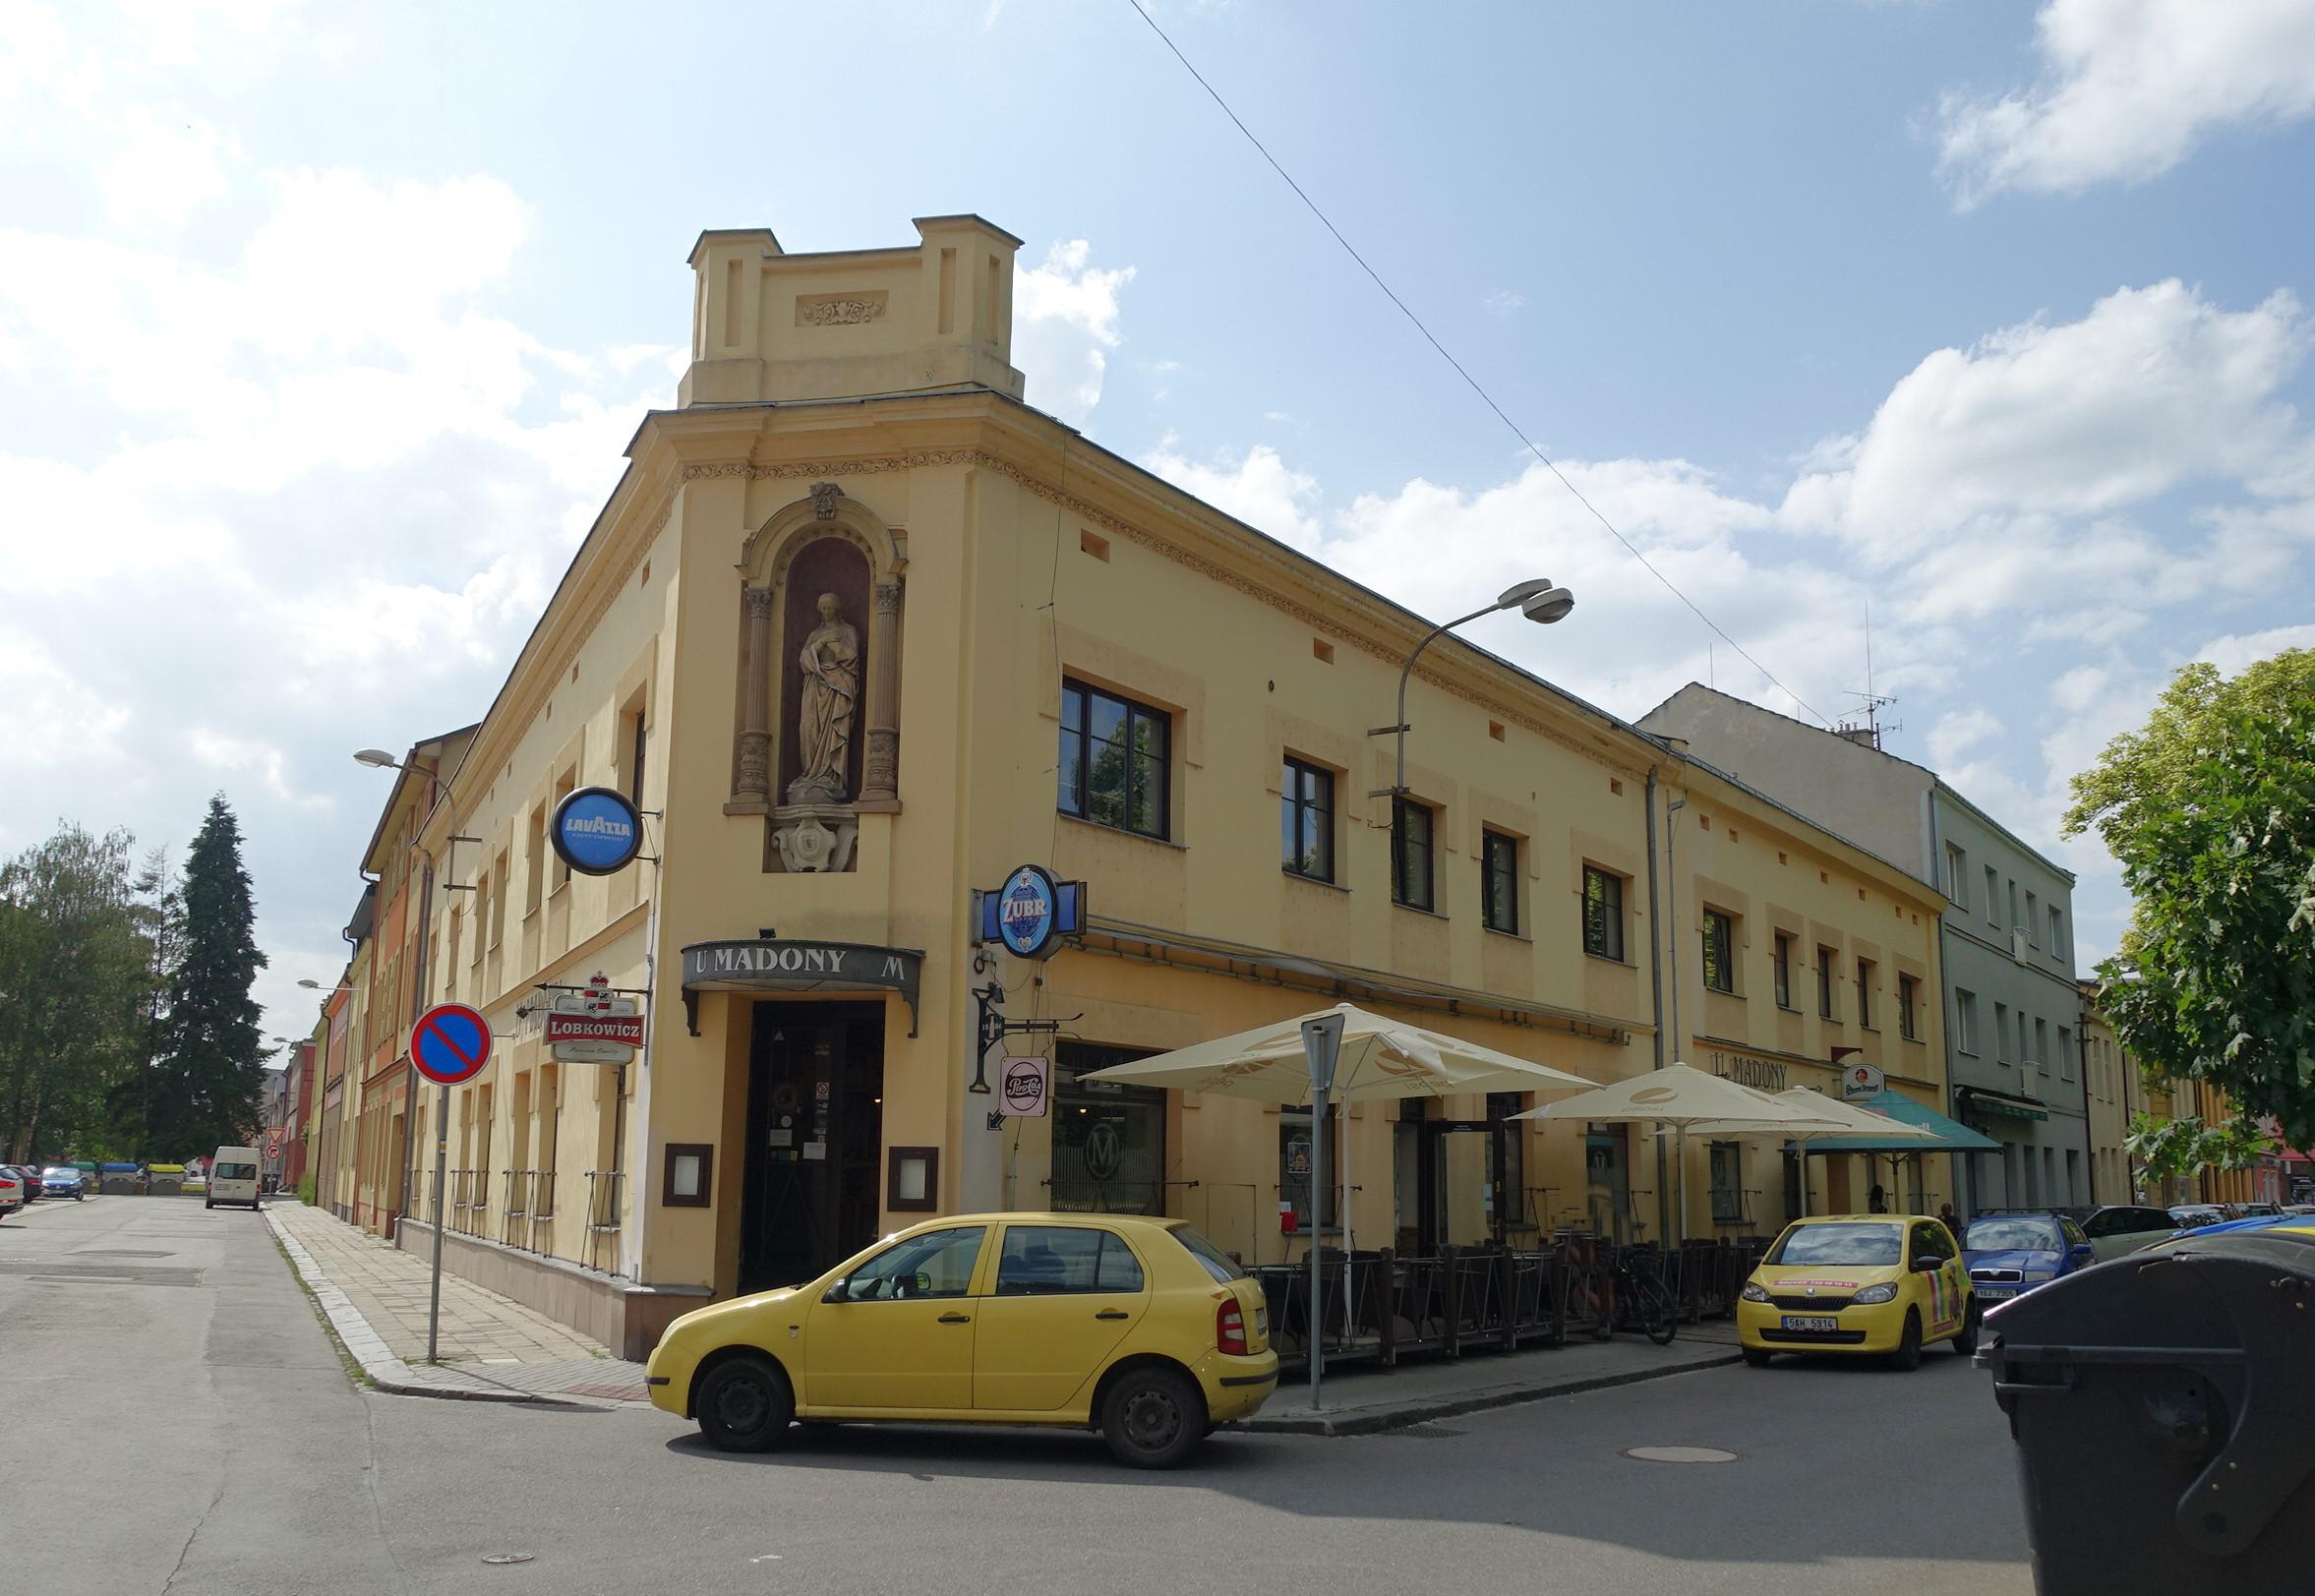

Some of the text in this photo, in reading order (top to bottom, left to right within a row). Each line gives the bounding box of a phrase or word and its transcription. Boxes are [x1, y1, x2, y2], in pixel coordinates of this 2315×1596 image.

[565, 816, 630, 836] LAVAZZA
[695, 947, 848, 973] U MADONY
[881, 956, 905, 979] M
[551, 1021, 639, 1037] LOBKOWICZ
[1733, 1056, 1787, 1091] MADONY
[1790, 1318, 1833, 1329] 5AH 5914
